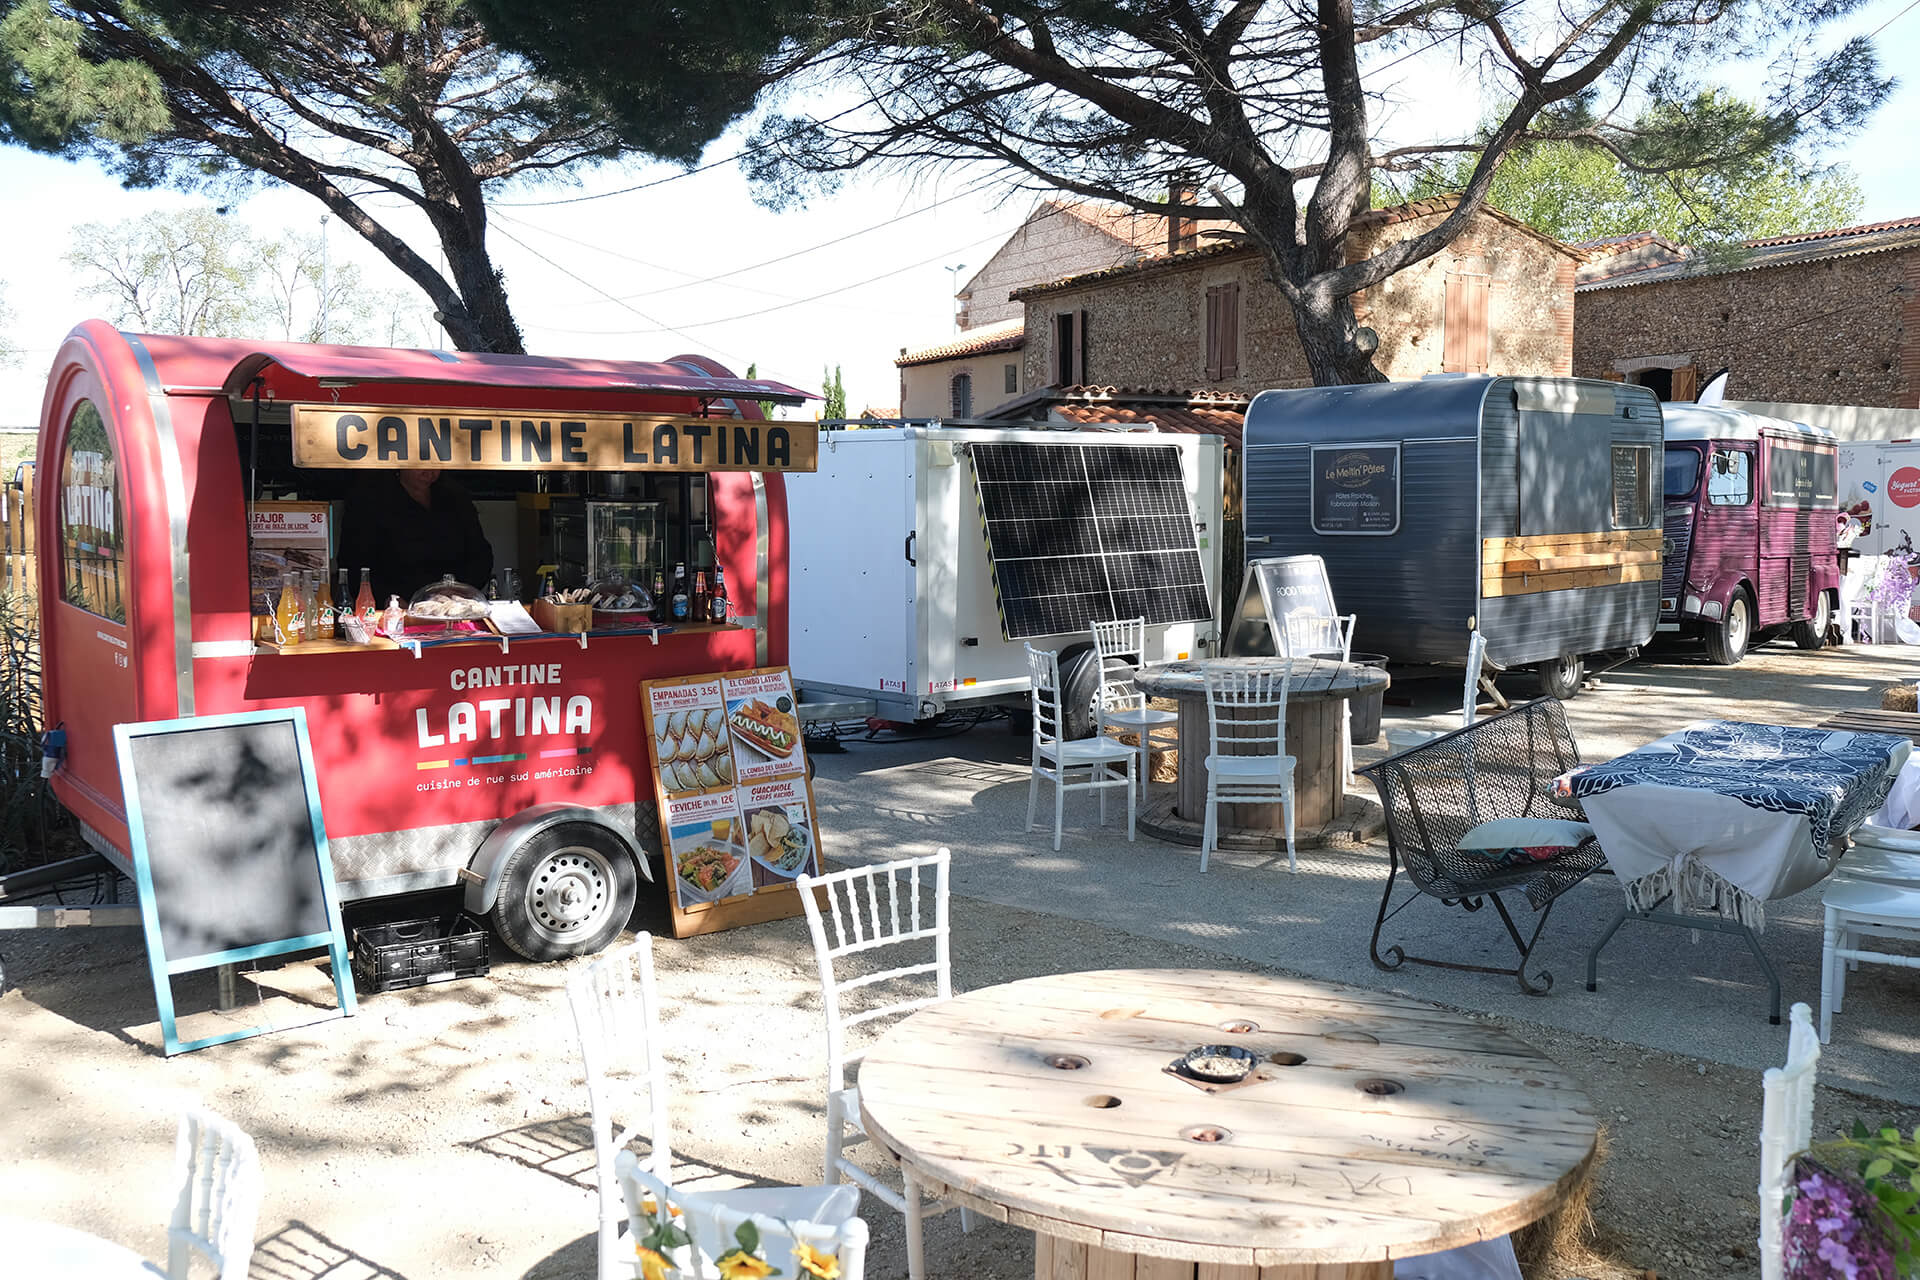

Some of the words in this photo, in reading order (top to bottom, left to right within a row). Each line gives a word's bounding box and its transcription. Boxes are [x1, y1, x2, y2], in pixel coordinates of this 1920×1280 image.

[336, 414, 588, 463] CANTINE
[623, 422, 791, 467] LATINA
[1325, 469, 1335, 480] Le
[1363, 463, 1385, 475] Pâtes
[1891, 481, 1917, 491] Yogurt
[66, 484, 115, 535] LATINA
[310, 513, 324, 524] 3€
[450, 663, 562, 691] CANTINE
[738, 677, 760, 687] COMBO
[760, 674, 782, 684] LATINO
[885, 680, 901, 689] ATAS
[934, 680, 953, 689] ATAS
[652, 688, 698, 701] EMPANADAS
[701, 686, 719, 696] 3.5€
[416, 695, 593, 749] LATINA
[747, 766, 765, 774] COMBO
[416, 779, 462, 792] cuisine
[467, 776, 481, 787] de
[486, 774, 505, 784] rue
[510, 771, 529, 782] sud
[534, 765, 593, 780] américaine
[751, 782, 792, 795] GUACAMOLE
[755, 793, 772, 802] CHIPS
[773, 790, 795, 800] NACHOS
[669, 799, 703, 814] CEVICHE
[720, 794, 735, 804] 12€
